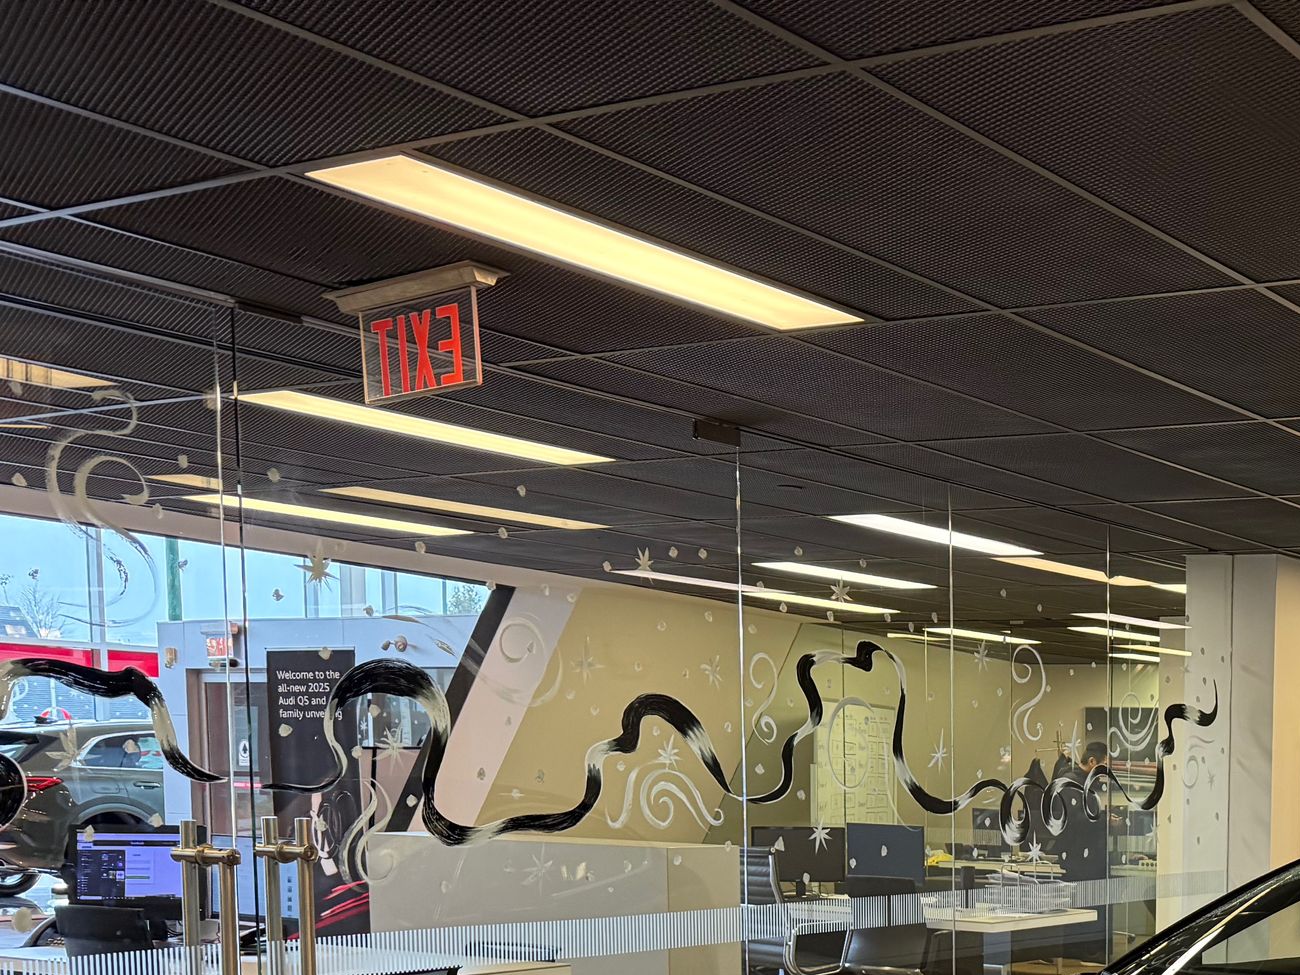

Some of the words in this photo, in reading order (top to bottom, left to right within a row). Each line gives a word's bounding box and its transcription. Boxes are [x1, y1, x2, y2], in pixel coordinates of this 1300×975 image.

[276, 670, 314, 680] Welcome
[315, 671, 324, 679] to
[326, 670, 340, 679] the
[278, 683, 306, 693] all-new
[308, 683, 330, 692] 2025
[279, 696, 295, 705] Audi
[297, 696, 309, 706] Q5
[311, 696, 326, 705] and
[280, 708, 303, 720] family
[305, 707, 342, 720] unveg
